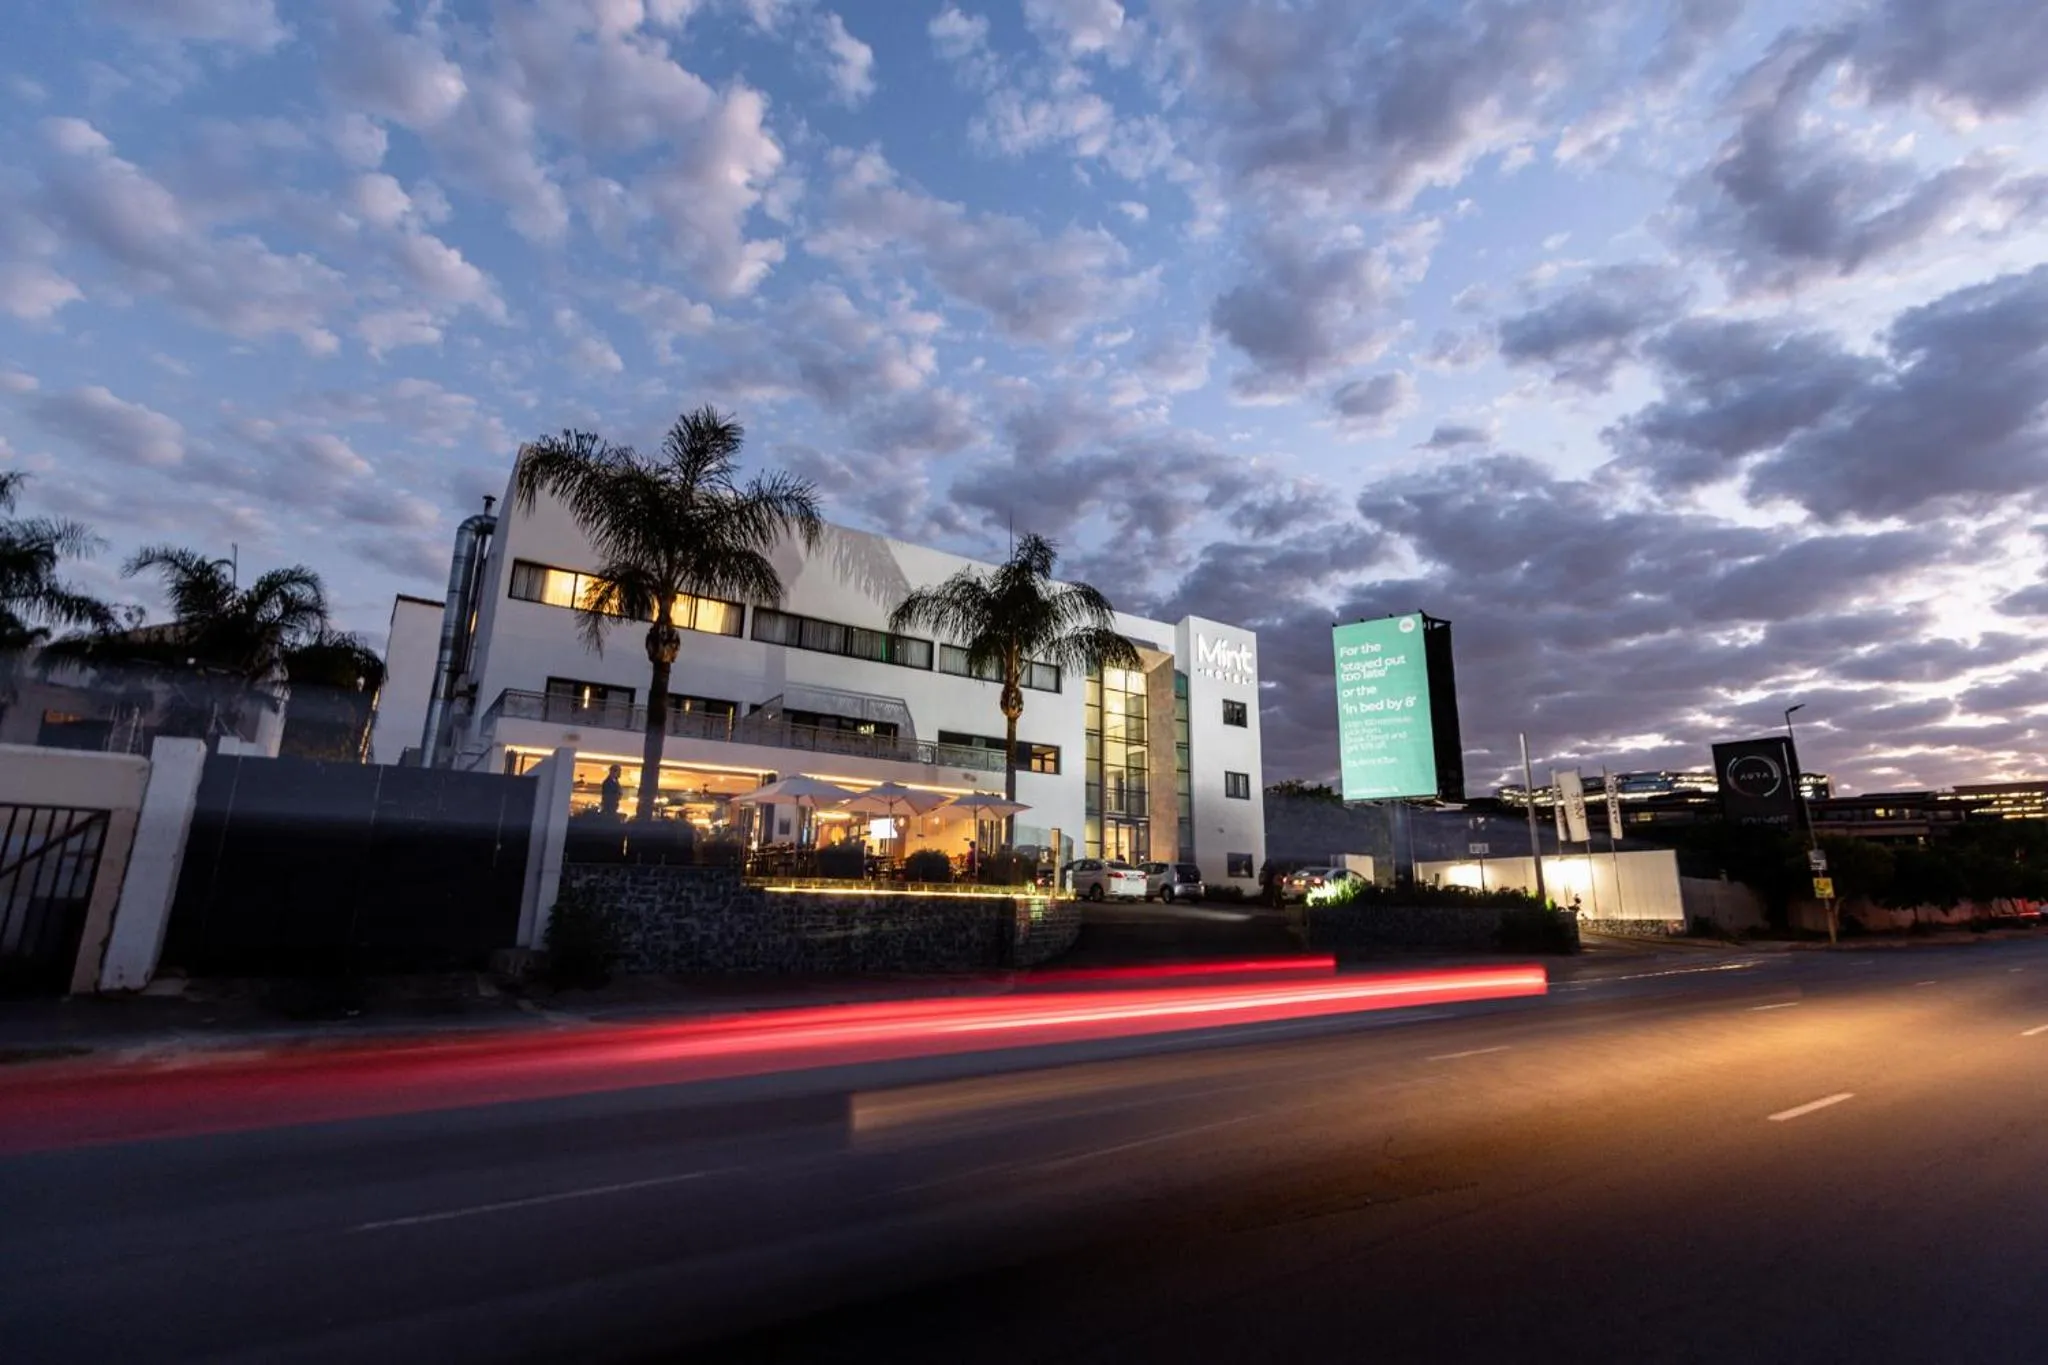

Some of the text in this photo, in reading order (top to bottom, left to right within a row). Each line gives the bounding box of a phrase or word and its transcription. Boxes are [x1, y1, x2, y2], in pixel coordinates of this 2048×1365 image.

[1198, 633, 1253, 674] Mint
[1340, 642, 1382, 657] For the
[1342, 685, 1377, 697] or the
[1359, 699, 1384, 713] bed
[1387, 697, 1403, 711] by
